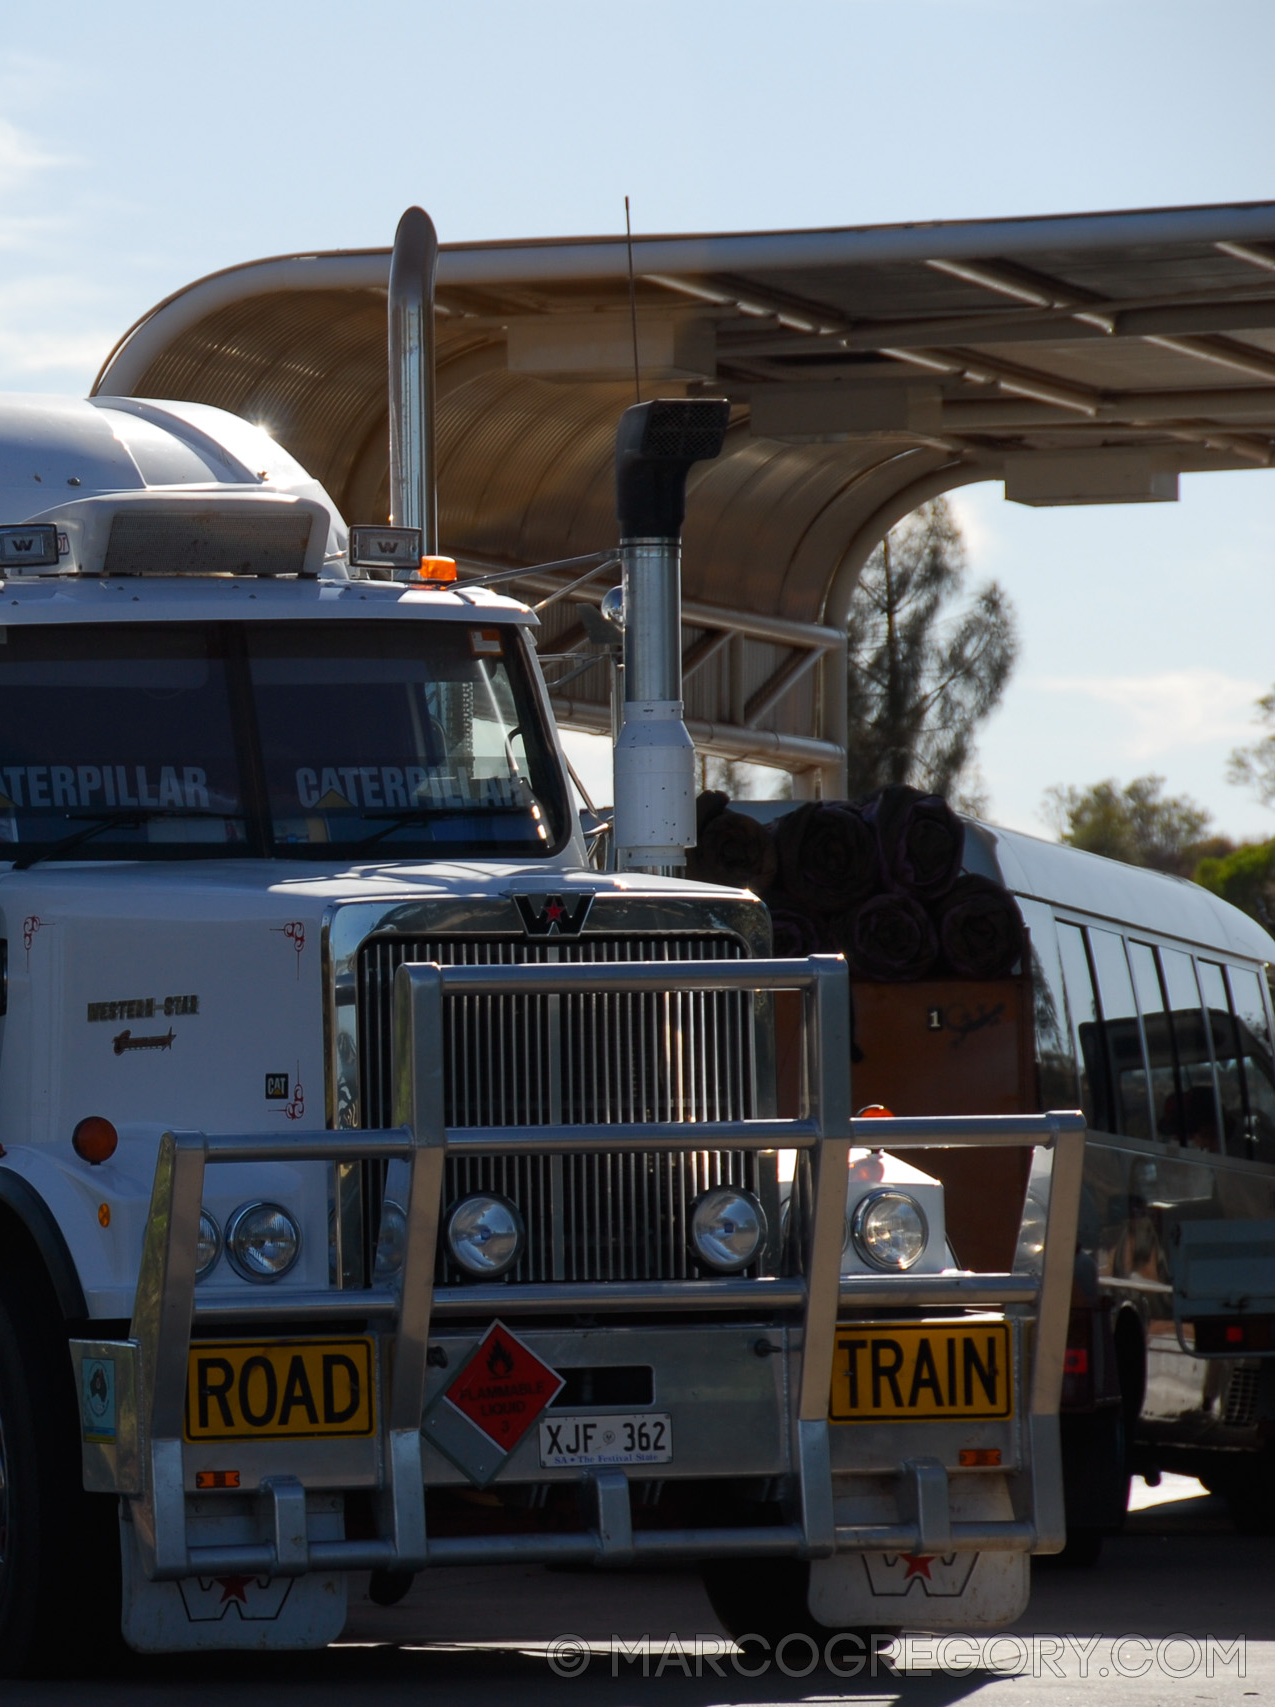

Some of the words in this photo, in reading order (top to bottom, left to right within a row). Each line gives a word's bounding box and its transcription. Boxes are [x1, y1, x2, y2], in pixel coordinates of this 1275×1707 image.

[295, 766, 525, 809] CATERPILLAR
[929, 1010, 942, 1029] 1
[268, 1077, 286, 1097] CAT
[838, 1337, 998, 1408] TRAIN
[198, 1355, 360, 1428] ROAD
[461, 1382, 544, 1401] FLAMMABLE
[481, 1401, 526, 1416] LIQUID
[501, 1420, 510, 1434] 3
[547, 1424, 597, 1455] XJF
[623, 1422, 665, 1452] 362
[554, 1456, 568, 1464] SA
[577, 1455, 594, 1464] The
[598, 1454, 633, 1463] Festival
[636, 1453, 659, 1462] State
